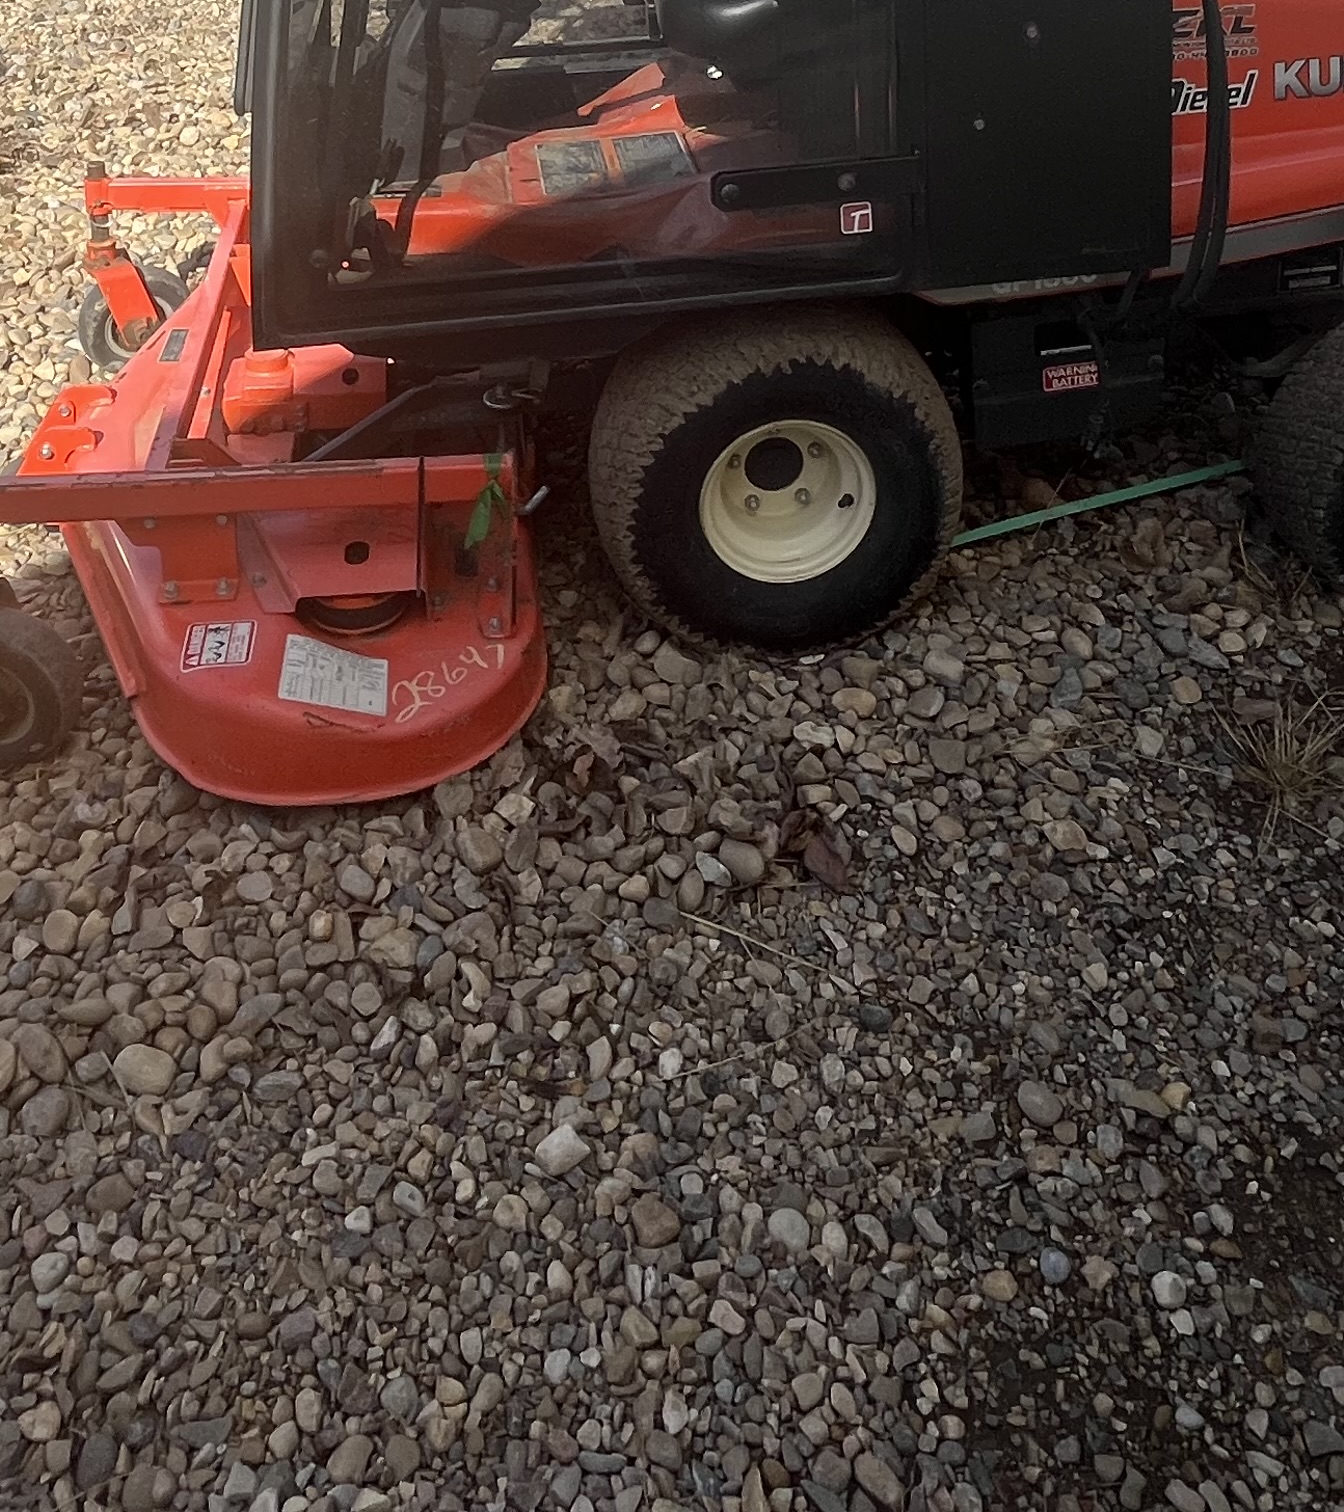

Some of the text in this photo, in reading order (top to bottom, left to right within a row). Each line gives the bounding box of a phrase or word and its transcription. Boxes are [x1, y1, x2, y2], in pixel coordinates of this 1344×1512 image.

[1046, 364, 1098, 379] WARNIN
[1052, 373, 1098, 389] BATTERY
[392, 643, 504, 723] 28647
